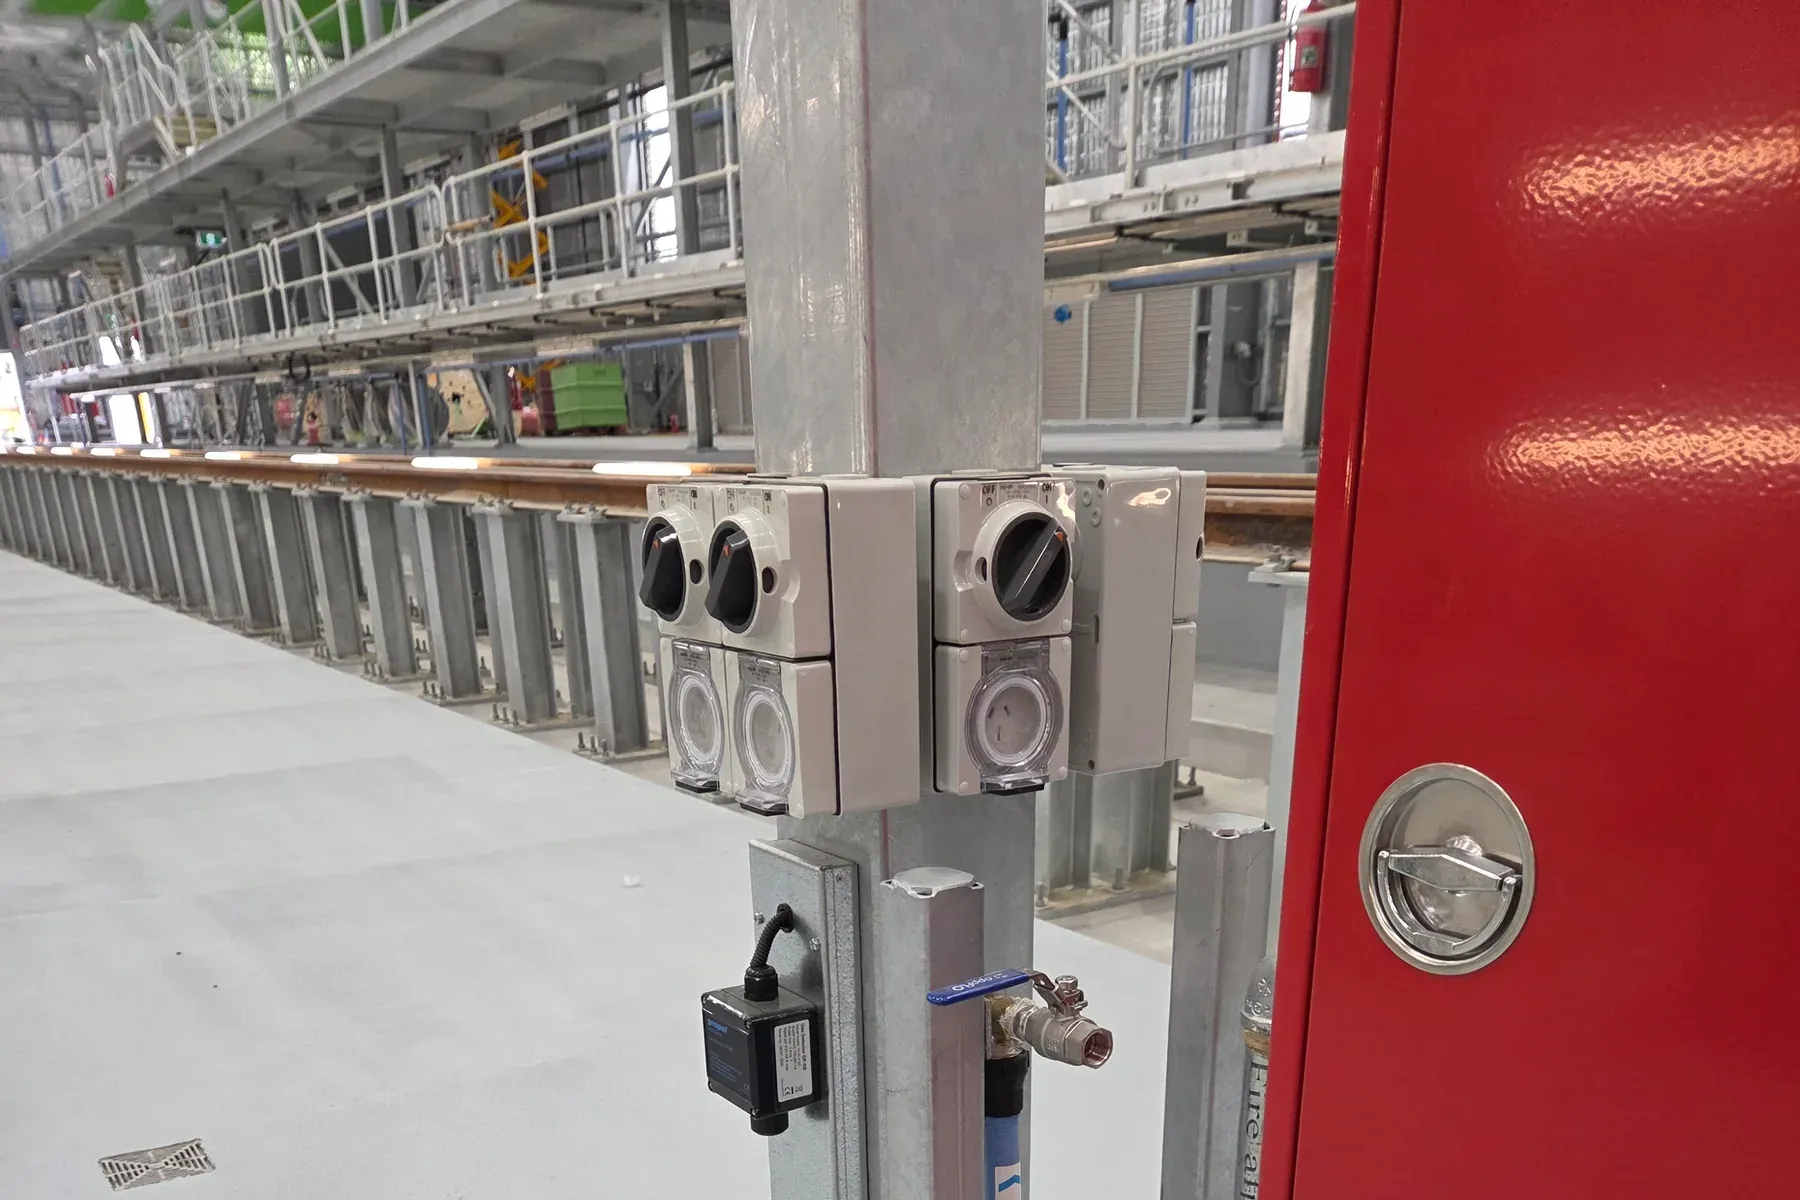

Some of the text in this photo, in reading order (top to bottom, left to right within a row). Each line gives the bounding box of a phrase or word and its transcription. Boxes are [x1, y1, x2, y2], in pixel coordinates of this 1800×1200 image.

[982, 485, 996, 495] OFF
[1042, 483, 1052, 492] ON
[1246, 1060, 1269, 1140] Fire
